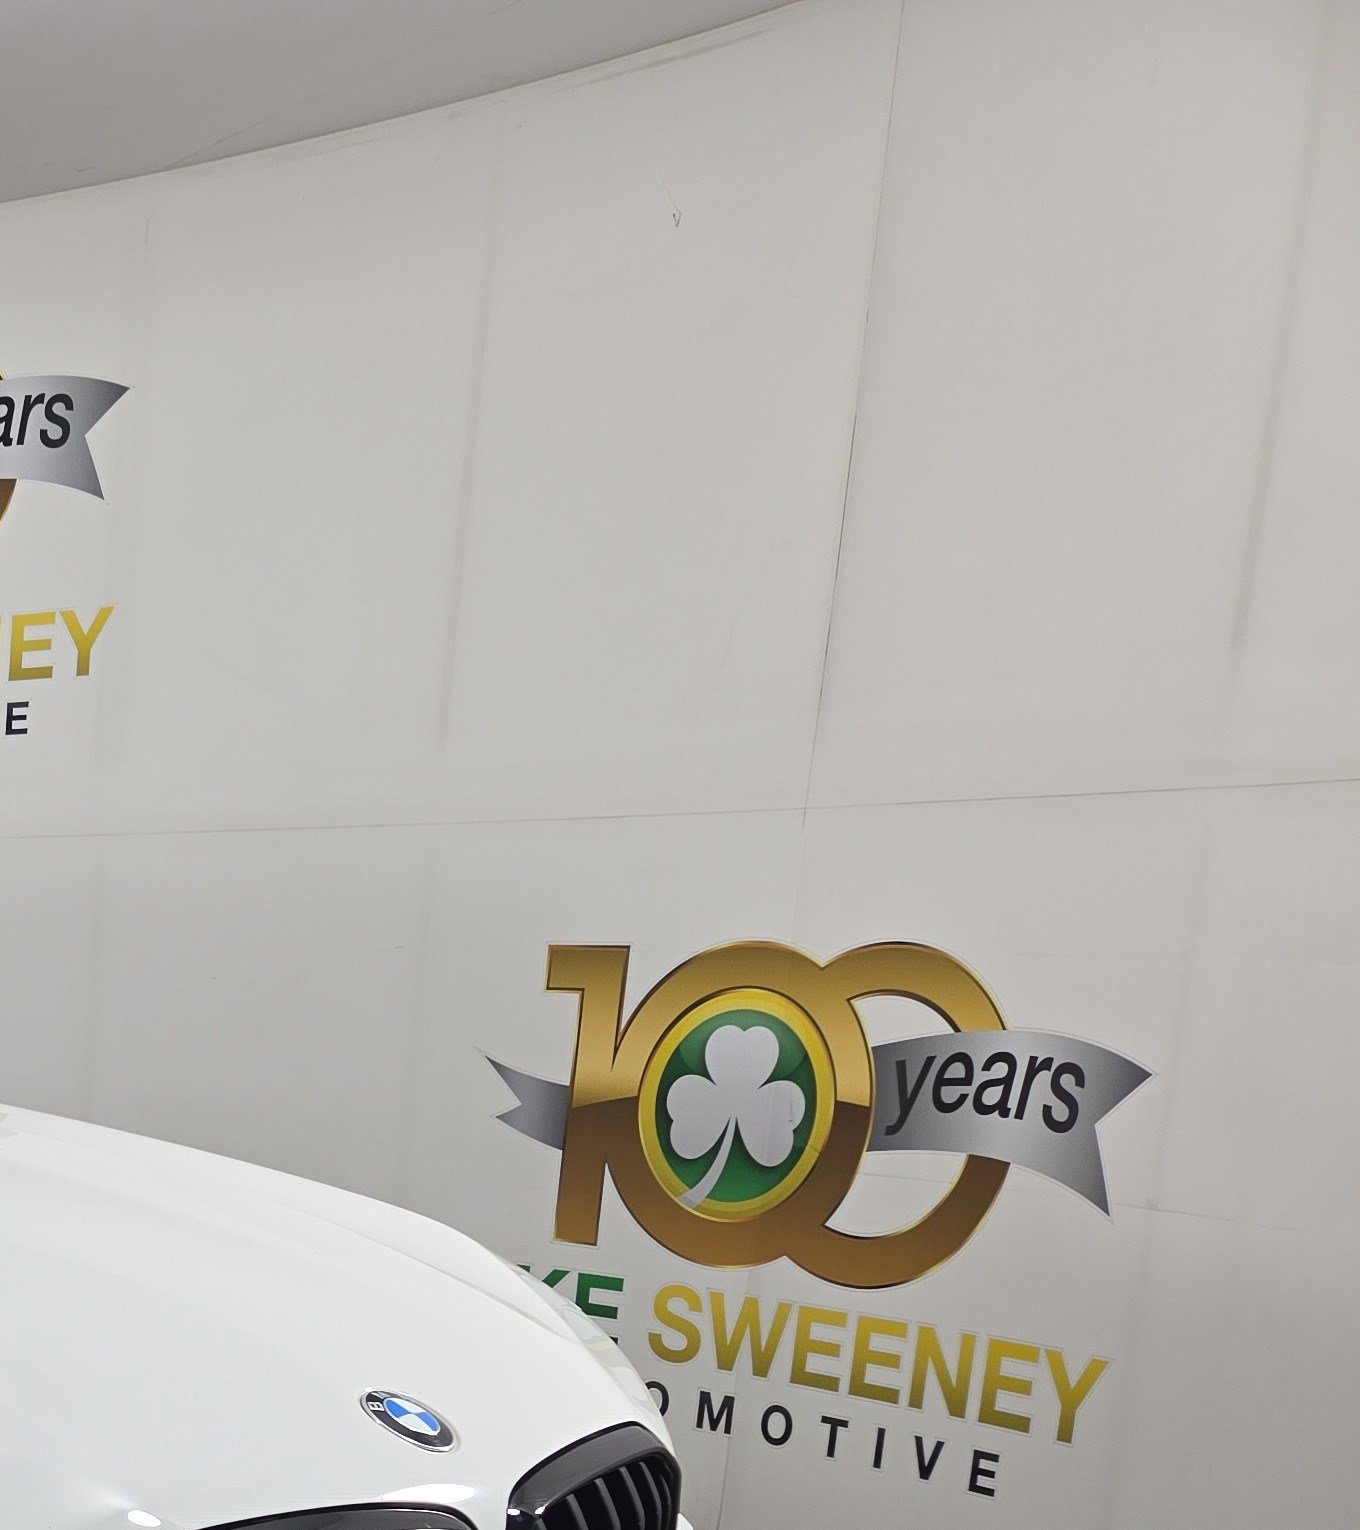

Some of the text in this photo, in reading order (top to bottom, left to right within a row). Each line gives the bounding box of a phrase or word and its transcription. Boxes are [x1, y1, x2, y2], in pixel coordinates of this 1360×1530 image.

[546, 940, 1086, 1289] 100 years
[646, 1381, 1002, 1500] OMOTIVE
[649, 1285, 1109, 1445] SWEENEY
